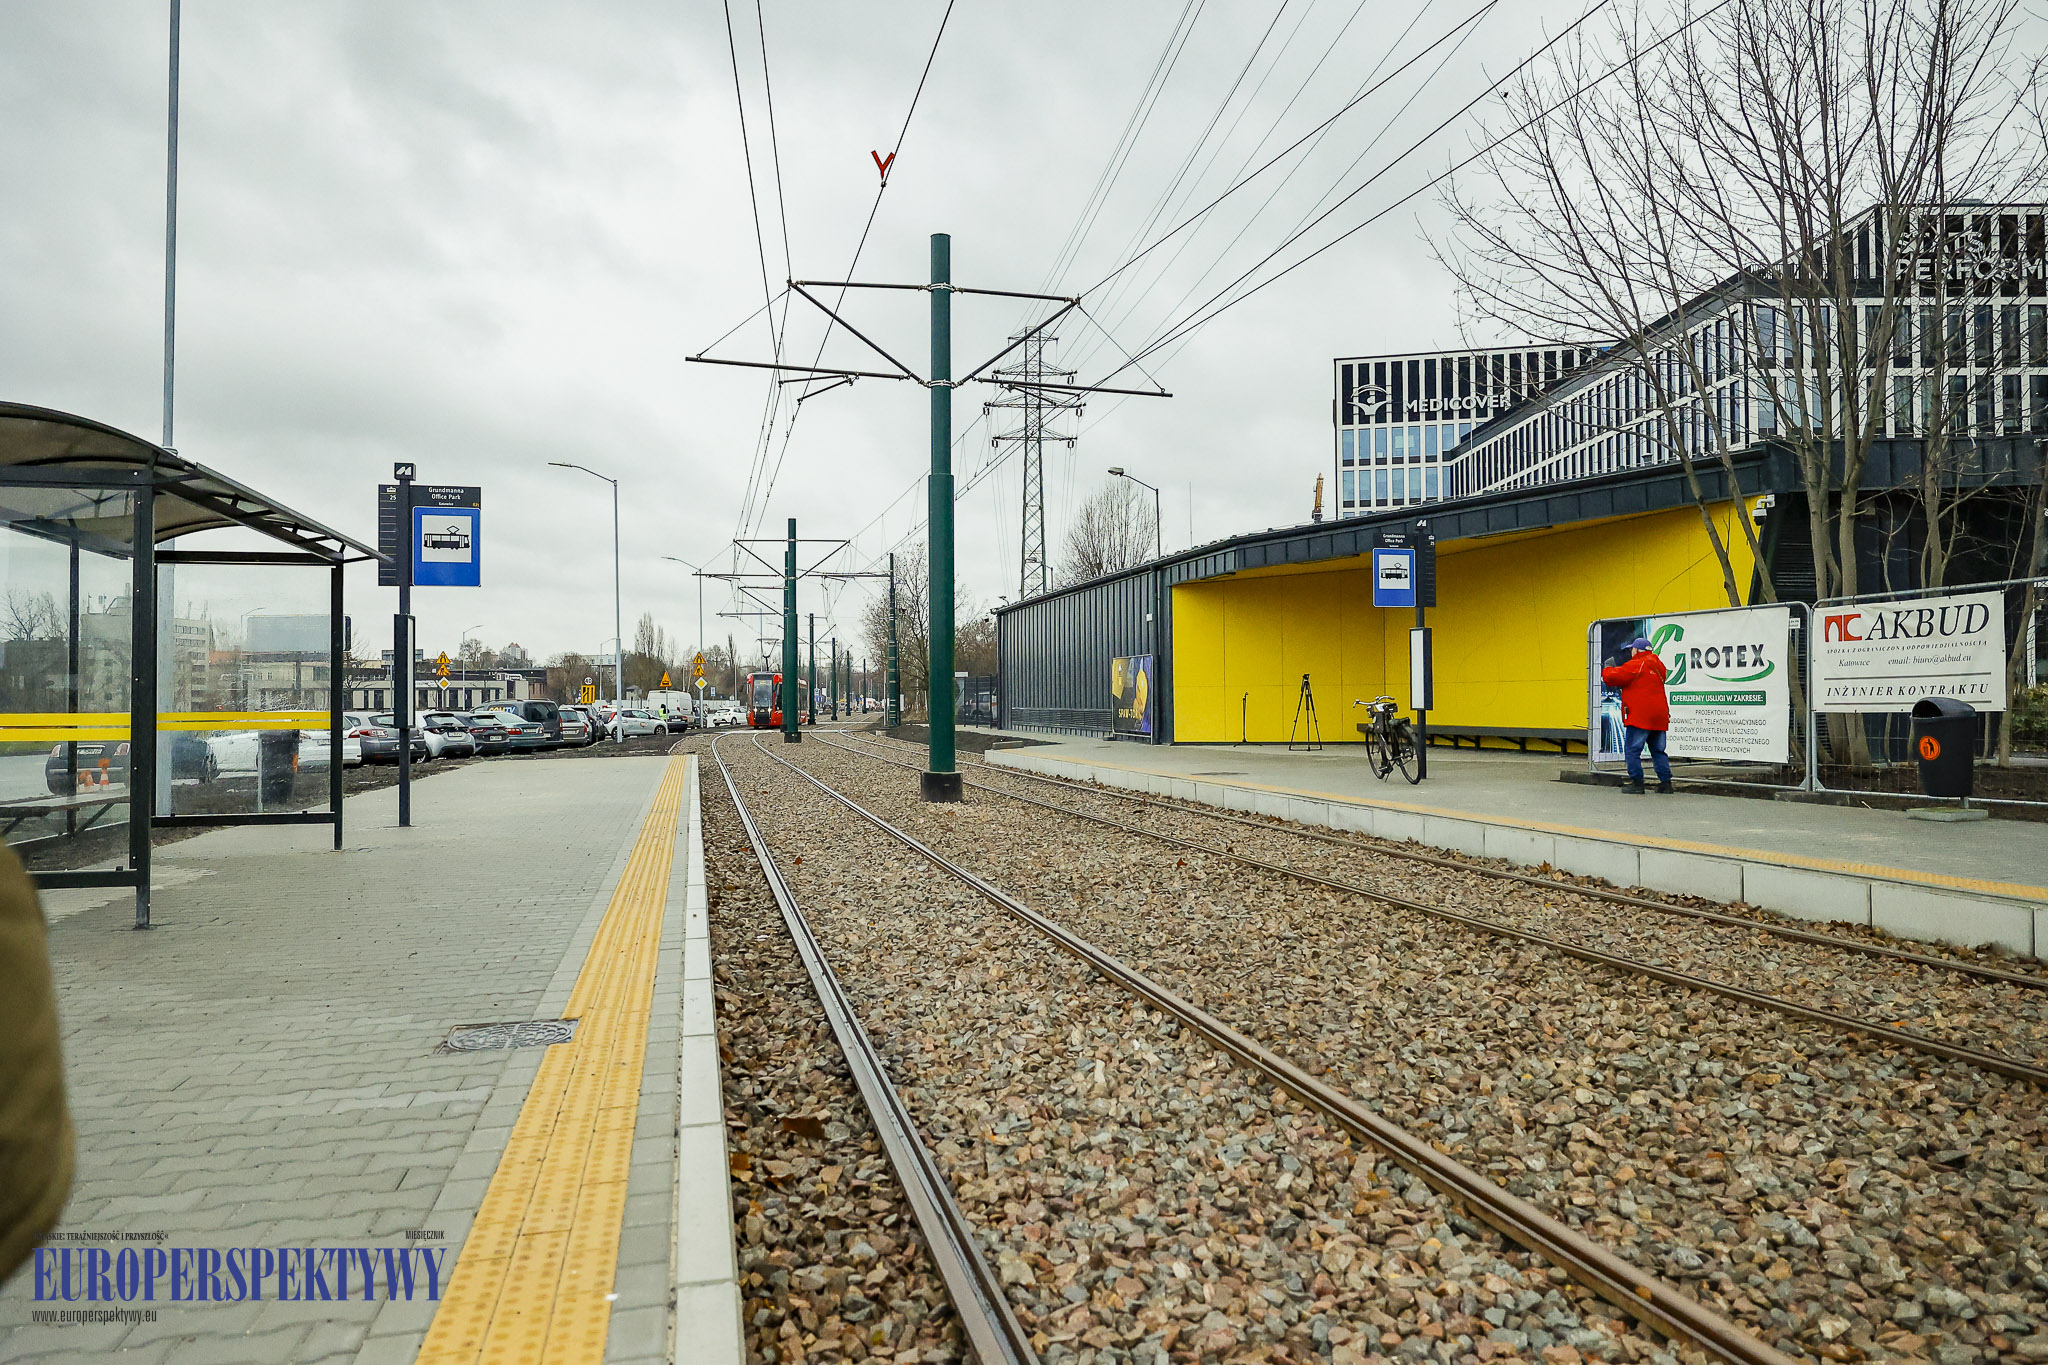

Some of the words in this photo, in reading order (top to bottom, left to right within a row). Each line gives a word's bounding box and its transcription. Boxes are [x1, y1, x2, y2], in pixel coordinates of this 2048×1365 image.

[1403, 394, 1512, 414] MEDICOVER
[1865, 603, 1991, 641] AKBUD
[1838, 658, 1870, 667] Katowice
[1888, 656, 1911, 665] email:
[1912, 653, 1972, 666] biuro@akbud.eu
[1827, 684, 1893, 697] INŻYNIER
[1897, 682, 1990, 697] KONTRAKTU
[1672, 694, 1706, 702] OFERUJEMY
[1733, 694, 1764, 702] ZAKRESIE:
